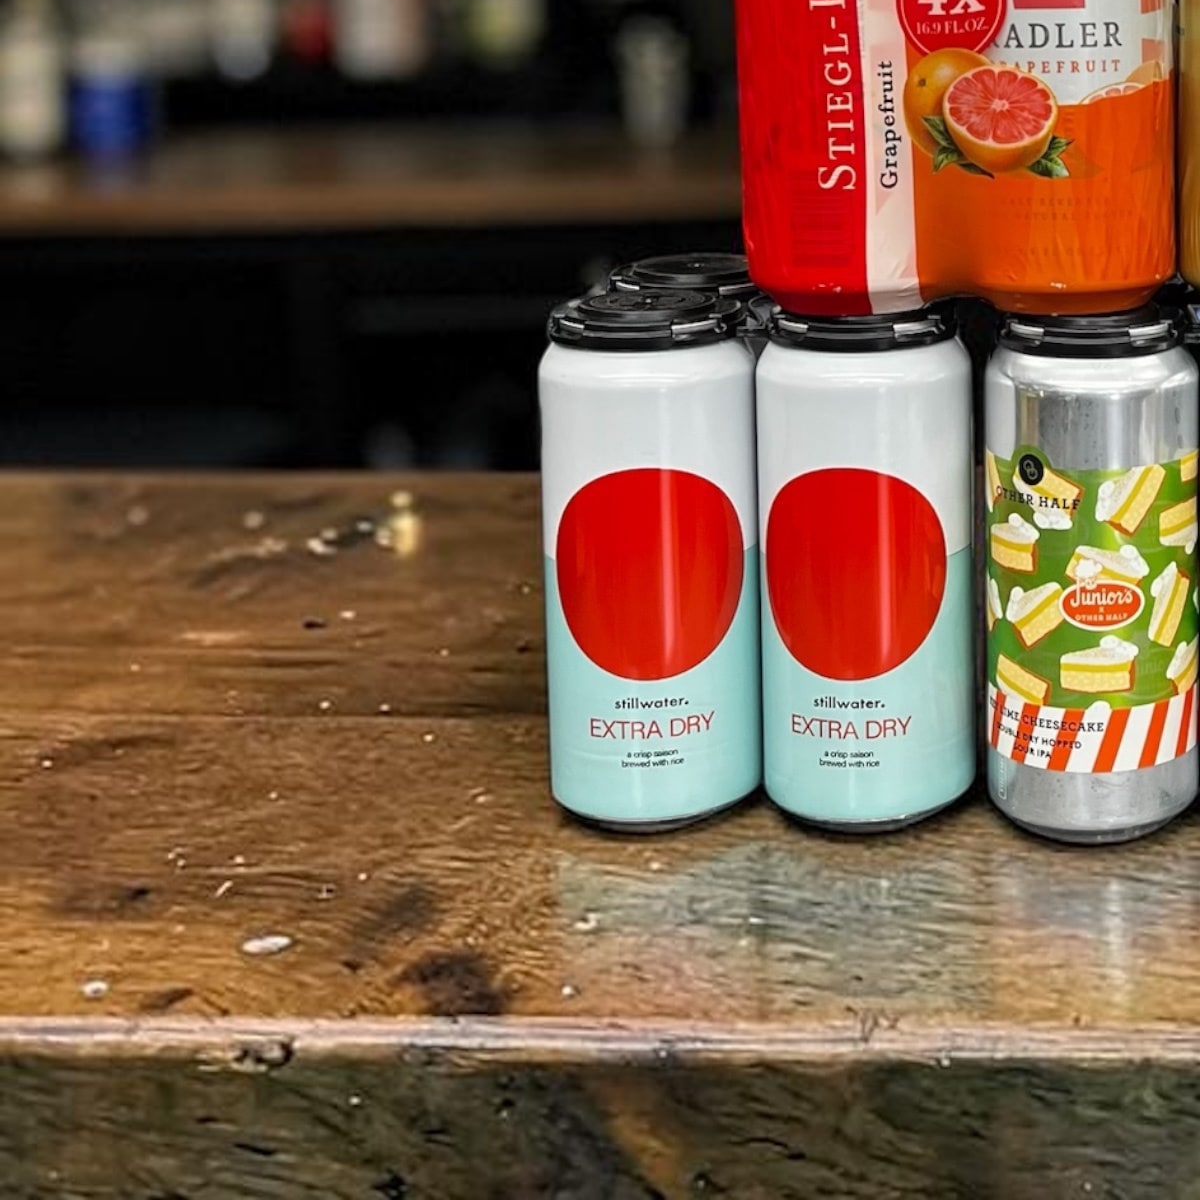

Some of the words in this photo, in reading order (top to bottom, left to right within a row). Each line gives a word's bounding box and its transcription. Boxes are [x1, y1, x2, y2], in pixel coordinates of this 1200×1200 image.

[916, 21, 941, 35] 16.9
[993, 22, 1122, 48] ADLER
[880, 60, 901, 189] Grapefruit
[996, 485, 1034, 505] OTHER
[1039, 497, 1081, 510] HALF
[1074, 613, 1104, 622] OTHER
[1106, 612, 1128, 622] HALF
[590, 717, 663, 739] EXTRA
[670, 710, 715, 737] DRY
[791, 713, 859, 739] EXTRA
[866, 715, 912, 739] DRY
[1022, 714, 1104, 732] CHEESECAKE
[1023, 732, 1040, 745] DRY
[1041, 737, 1082, 750] HOPPED
[633, 751, 652, 760] crisp
[654, 748, 678, 757] saison
[830, 750, 848, 760] crisp
[850, 750, 874, 758] saison
[1014, 743, 1035, 757] SOUR
[1036, 749, 1052, 759] IPA
[621, 760, 650, 768] brewed
[652, 758, 669, 767] with
[670, 757, 685, 765] rice
[819, 758, 846, 768] brewed
[848, 759, 865, 768] with
